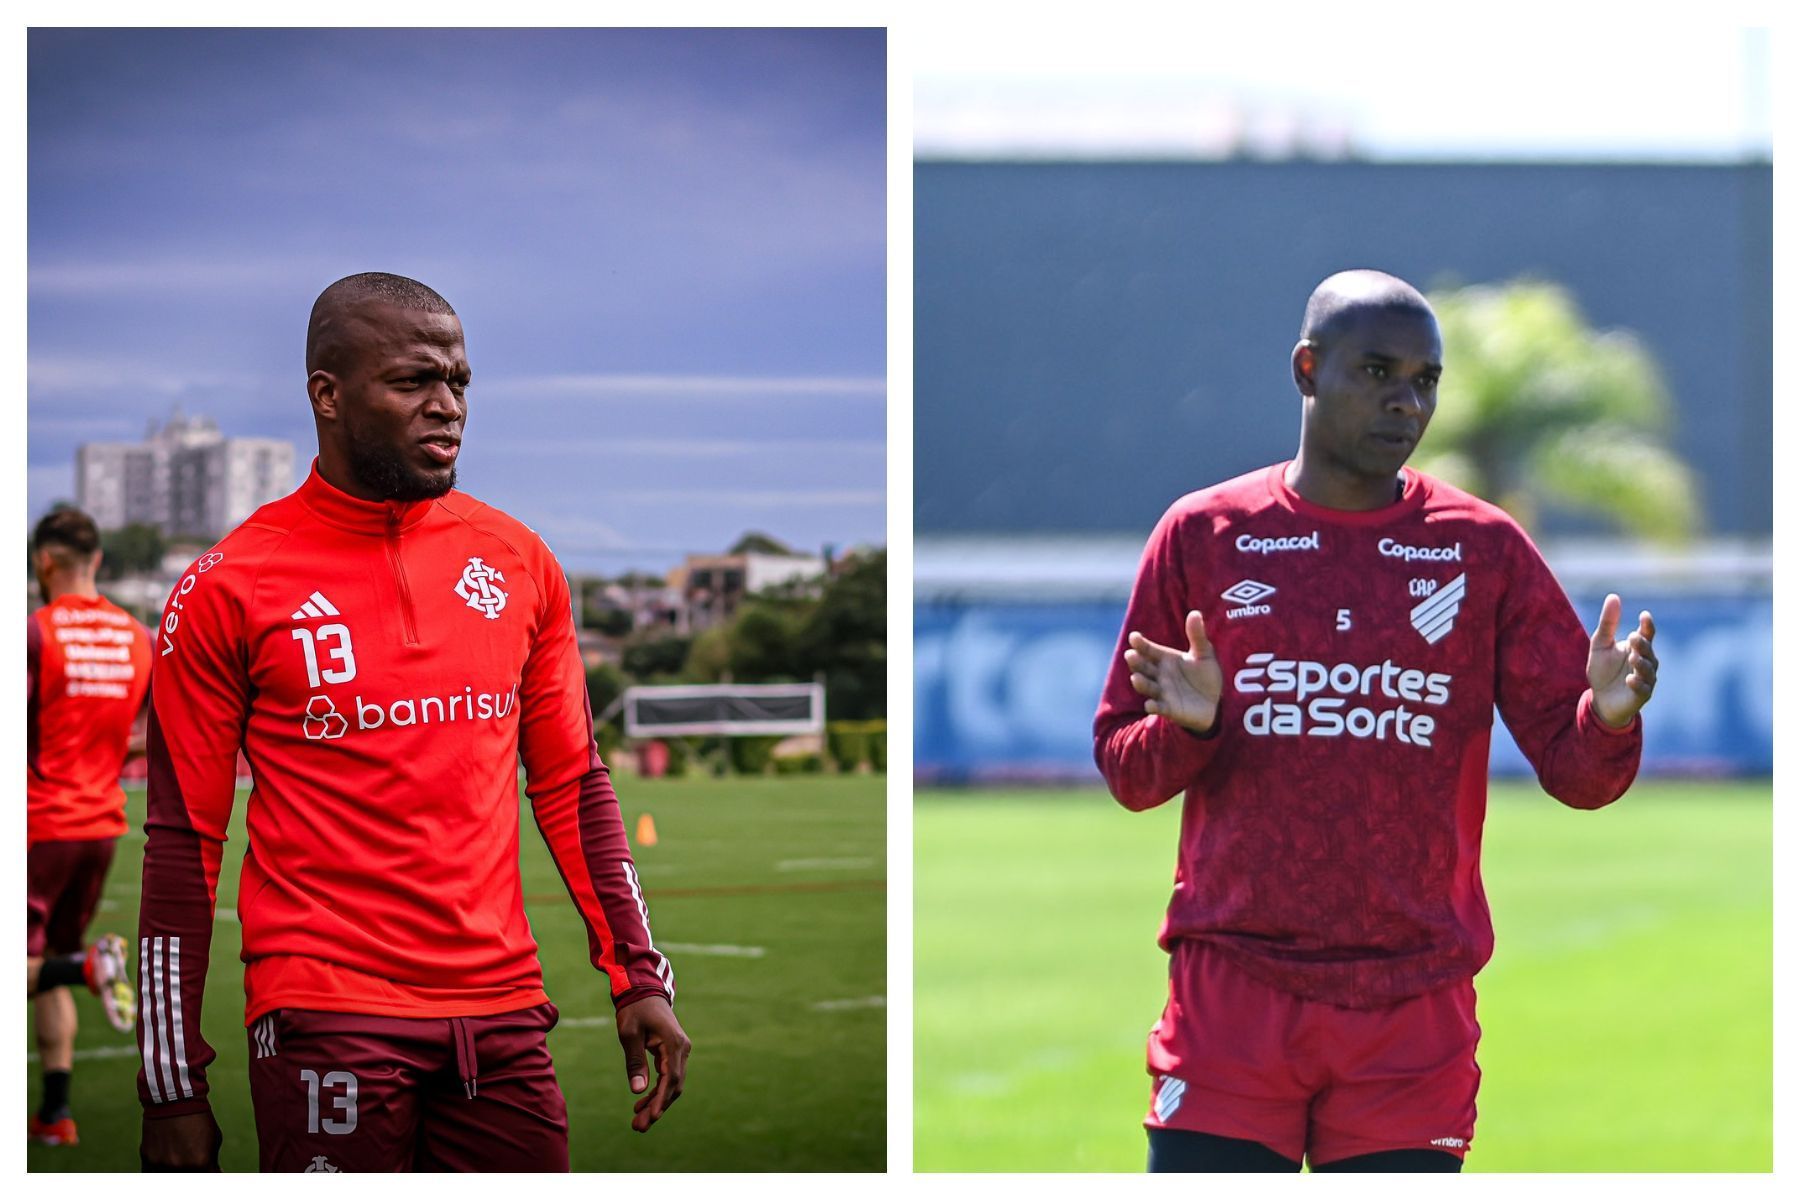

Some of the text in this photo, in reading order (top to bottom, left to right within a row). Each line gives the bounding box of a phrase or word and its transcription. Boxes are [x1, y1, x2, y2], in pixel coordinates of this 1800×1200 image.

[1235, 531, 1320, 554] Copacol
[1377, 538, 1462, 561] Copacol
[1226, 603, 1271, 619] umbro
[1408, 578, 1437, 597] CAP
[161, 574, 196, 656] vero
[1336, 609, 1351, 630] 5
[291, 623, 358, 688] 13
[1233, 653, 1452, 705] Esportes
[355, 683, 517, 730] banrisul
[1243, 697, 1436, 747] da Sorte
[300, 1069, 358, 1135] 13
